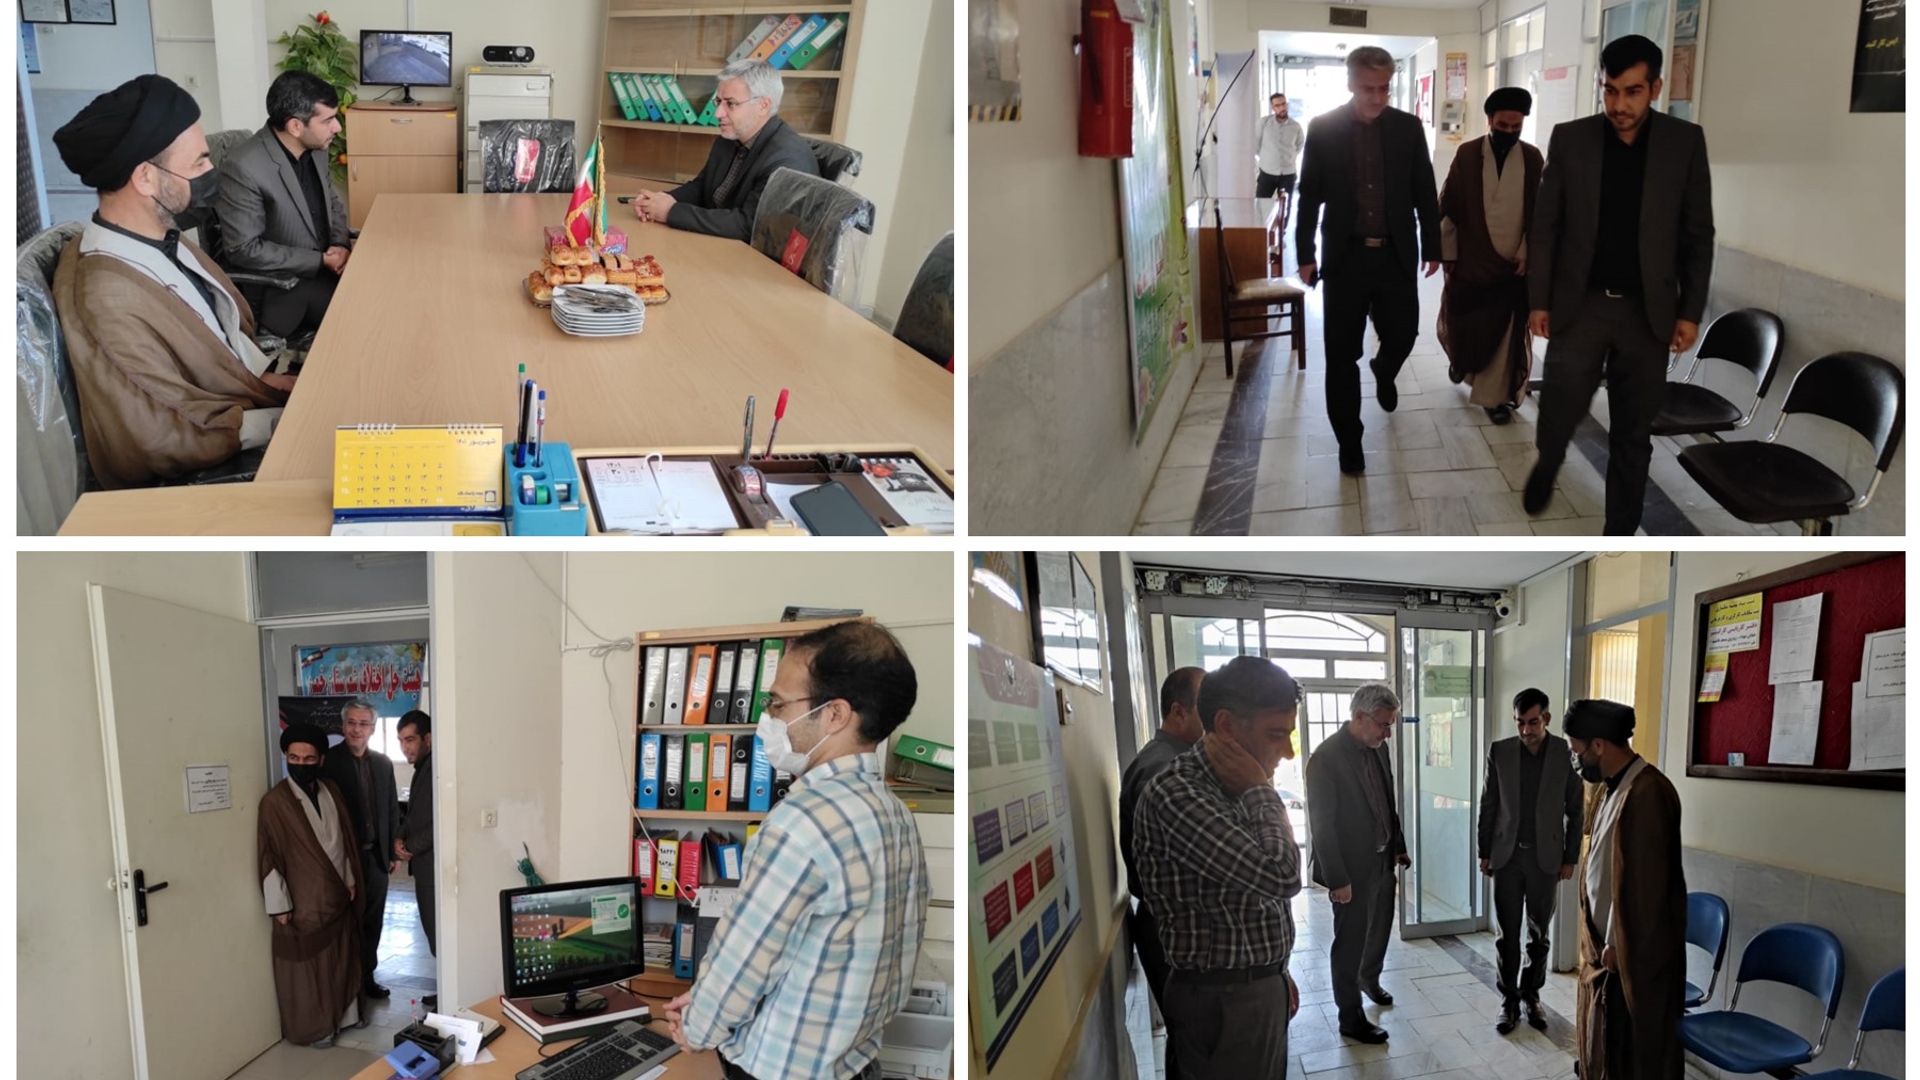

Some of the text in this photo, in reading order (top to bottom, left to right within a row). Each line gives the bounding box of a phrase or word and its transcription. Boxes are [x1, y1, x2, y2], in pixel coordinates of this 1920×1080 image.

[469, 438, 496, 447] شهریور
[359, 662, 386, 693] اختلاف
[387, 661, 400, 701] حل
